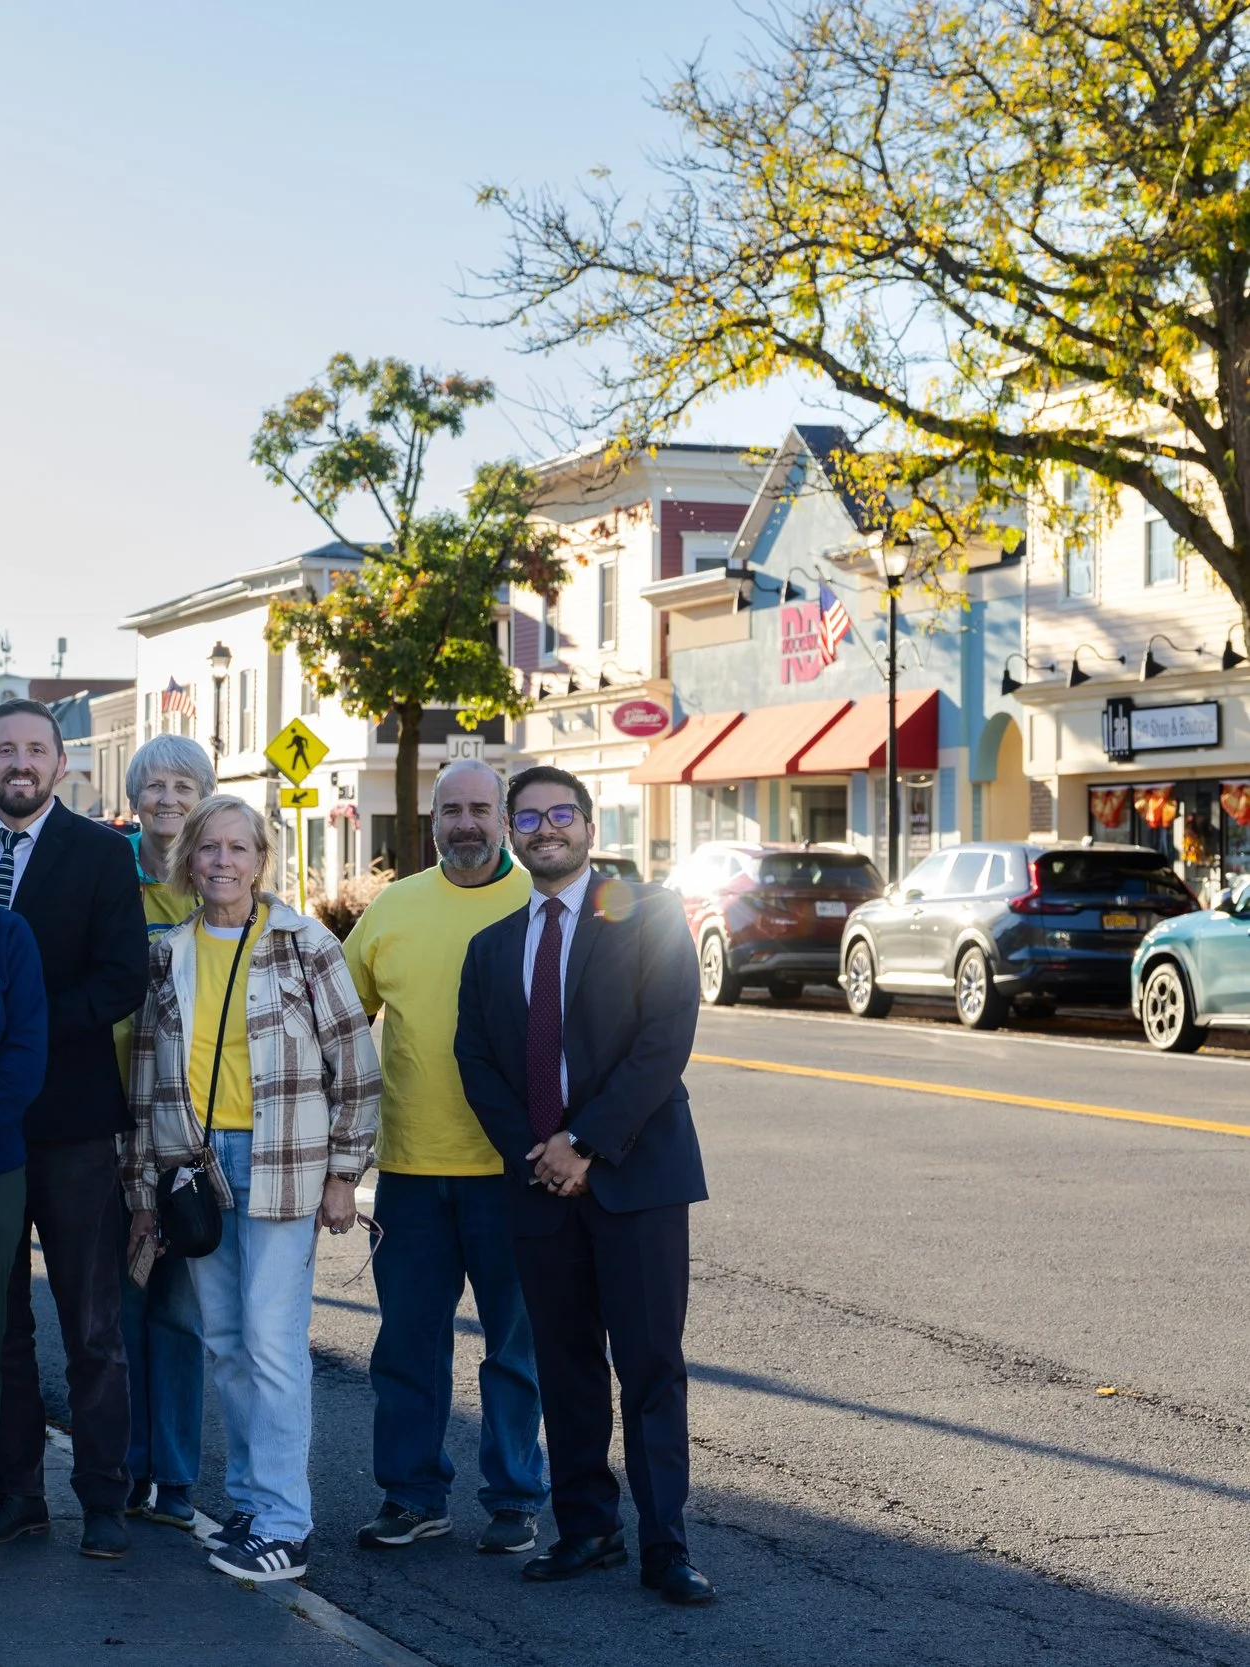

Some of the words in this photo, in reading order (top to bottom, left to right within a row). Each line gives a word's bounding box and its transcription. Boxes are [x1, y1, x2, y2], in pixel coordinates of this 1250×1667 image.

[1151, 718, 1169, 740] Shop
[1180, 715, 1215, 738] Boutique
[450, 740, 481, 758] JCT
